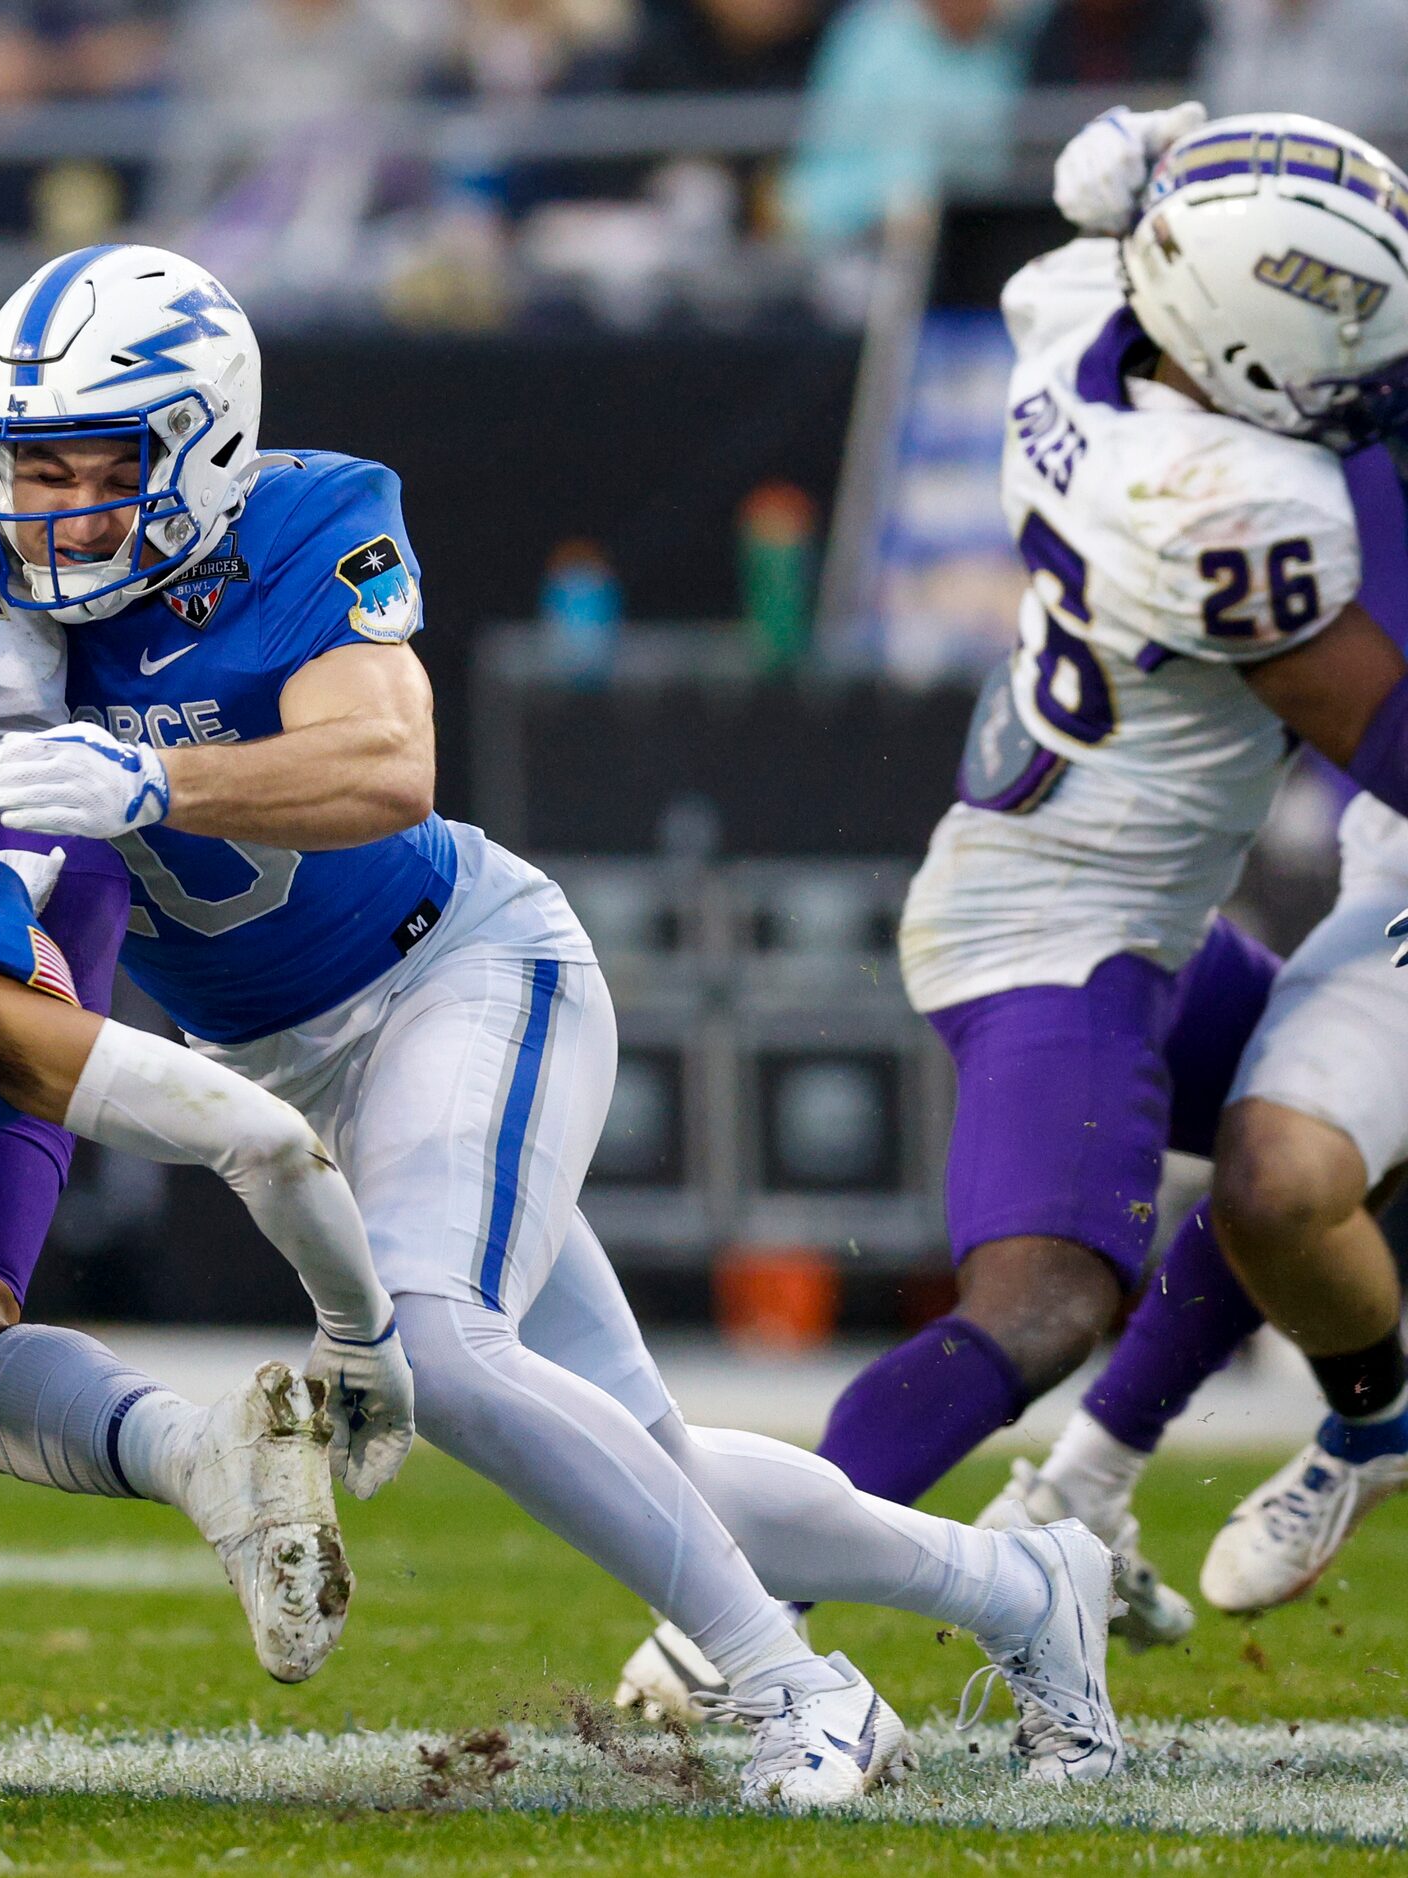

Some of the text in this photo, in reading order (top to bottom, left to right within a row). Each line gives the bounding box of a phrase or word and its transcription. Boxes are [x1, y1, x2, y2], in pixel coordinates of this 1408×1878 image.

[192, 560, 239, 577] FORCES
[176, 581, 212, 597] BOWL
[1198, 537, 1320, 636] 26
